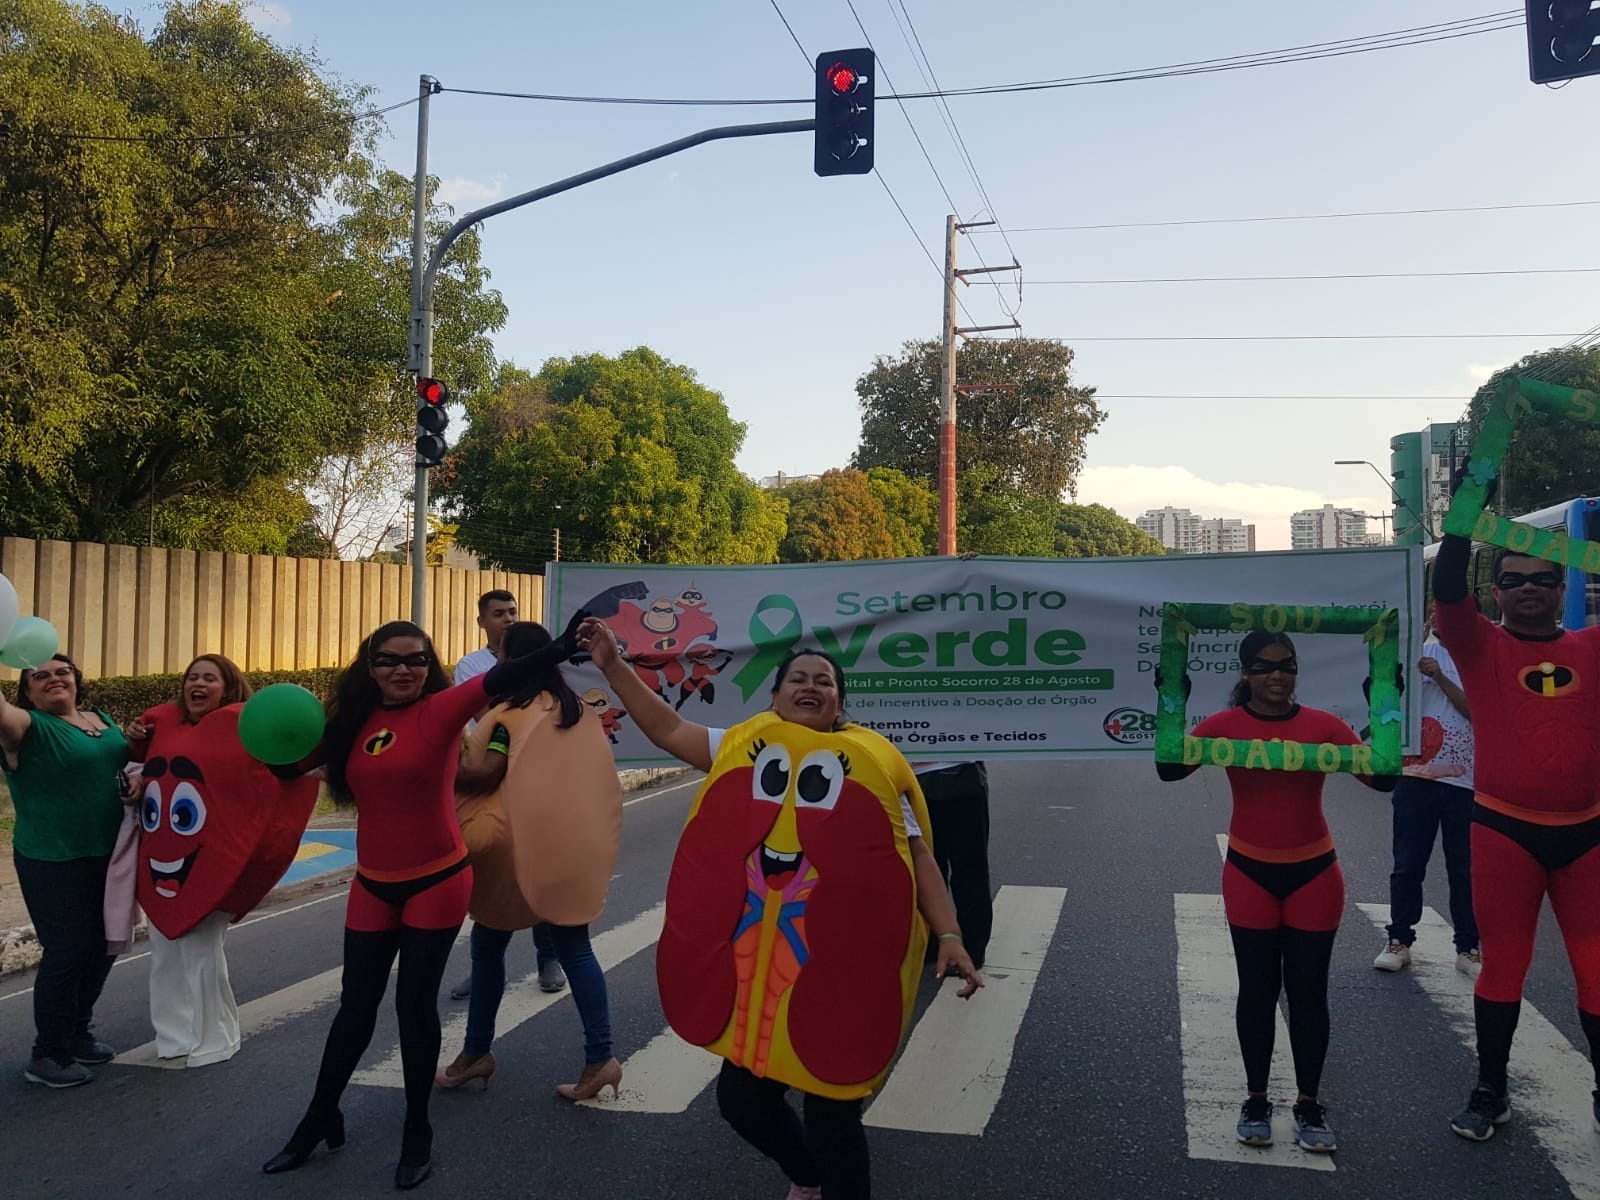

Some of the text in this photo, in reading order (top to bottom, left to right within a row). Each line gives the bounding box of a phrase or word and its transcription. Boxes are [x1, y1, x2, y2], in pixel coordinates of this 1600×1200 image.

[835, 584, 1068, 616] Setembro
[1139, 605, 1163, 618] Ne
[1229, 602, 1322, 635] SOU
[1137, 624, 1159, 636] te
[811, 617, 1087, 668] Verde
[1137, 640, 1239, 654] Se Incrí
[1187, 655, 1240, 674] Órgã
[875, 680, 885, 688] e
[888, 678, 938, 688] Pronto
[941, 676, 999, 688] Socorro
[1002, 676, 1021, 686] 28
[1024, 675, 1044, 686] de
[1047, 675, 1100, 687] Agosto
[855, 699, 874, 709] de
[879, 696, 949, 708] Incentivo
[966, 696, 1023, 708] Doação
[1027, 695, 1046, 706] de
[1050, 694, 1097, 707] Órgão
[851, 719, 930, 731] etembro
[1120, 713, 1157, 732] 28
[907, 731, 966, 745] Órgãos
[970, 733, 979, 742] e
[984, 731, 1047, 742] Tecidos
[1183, 735, 1375, 776] DOADOR
